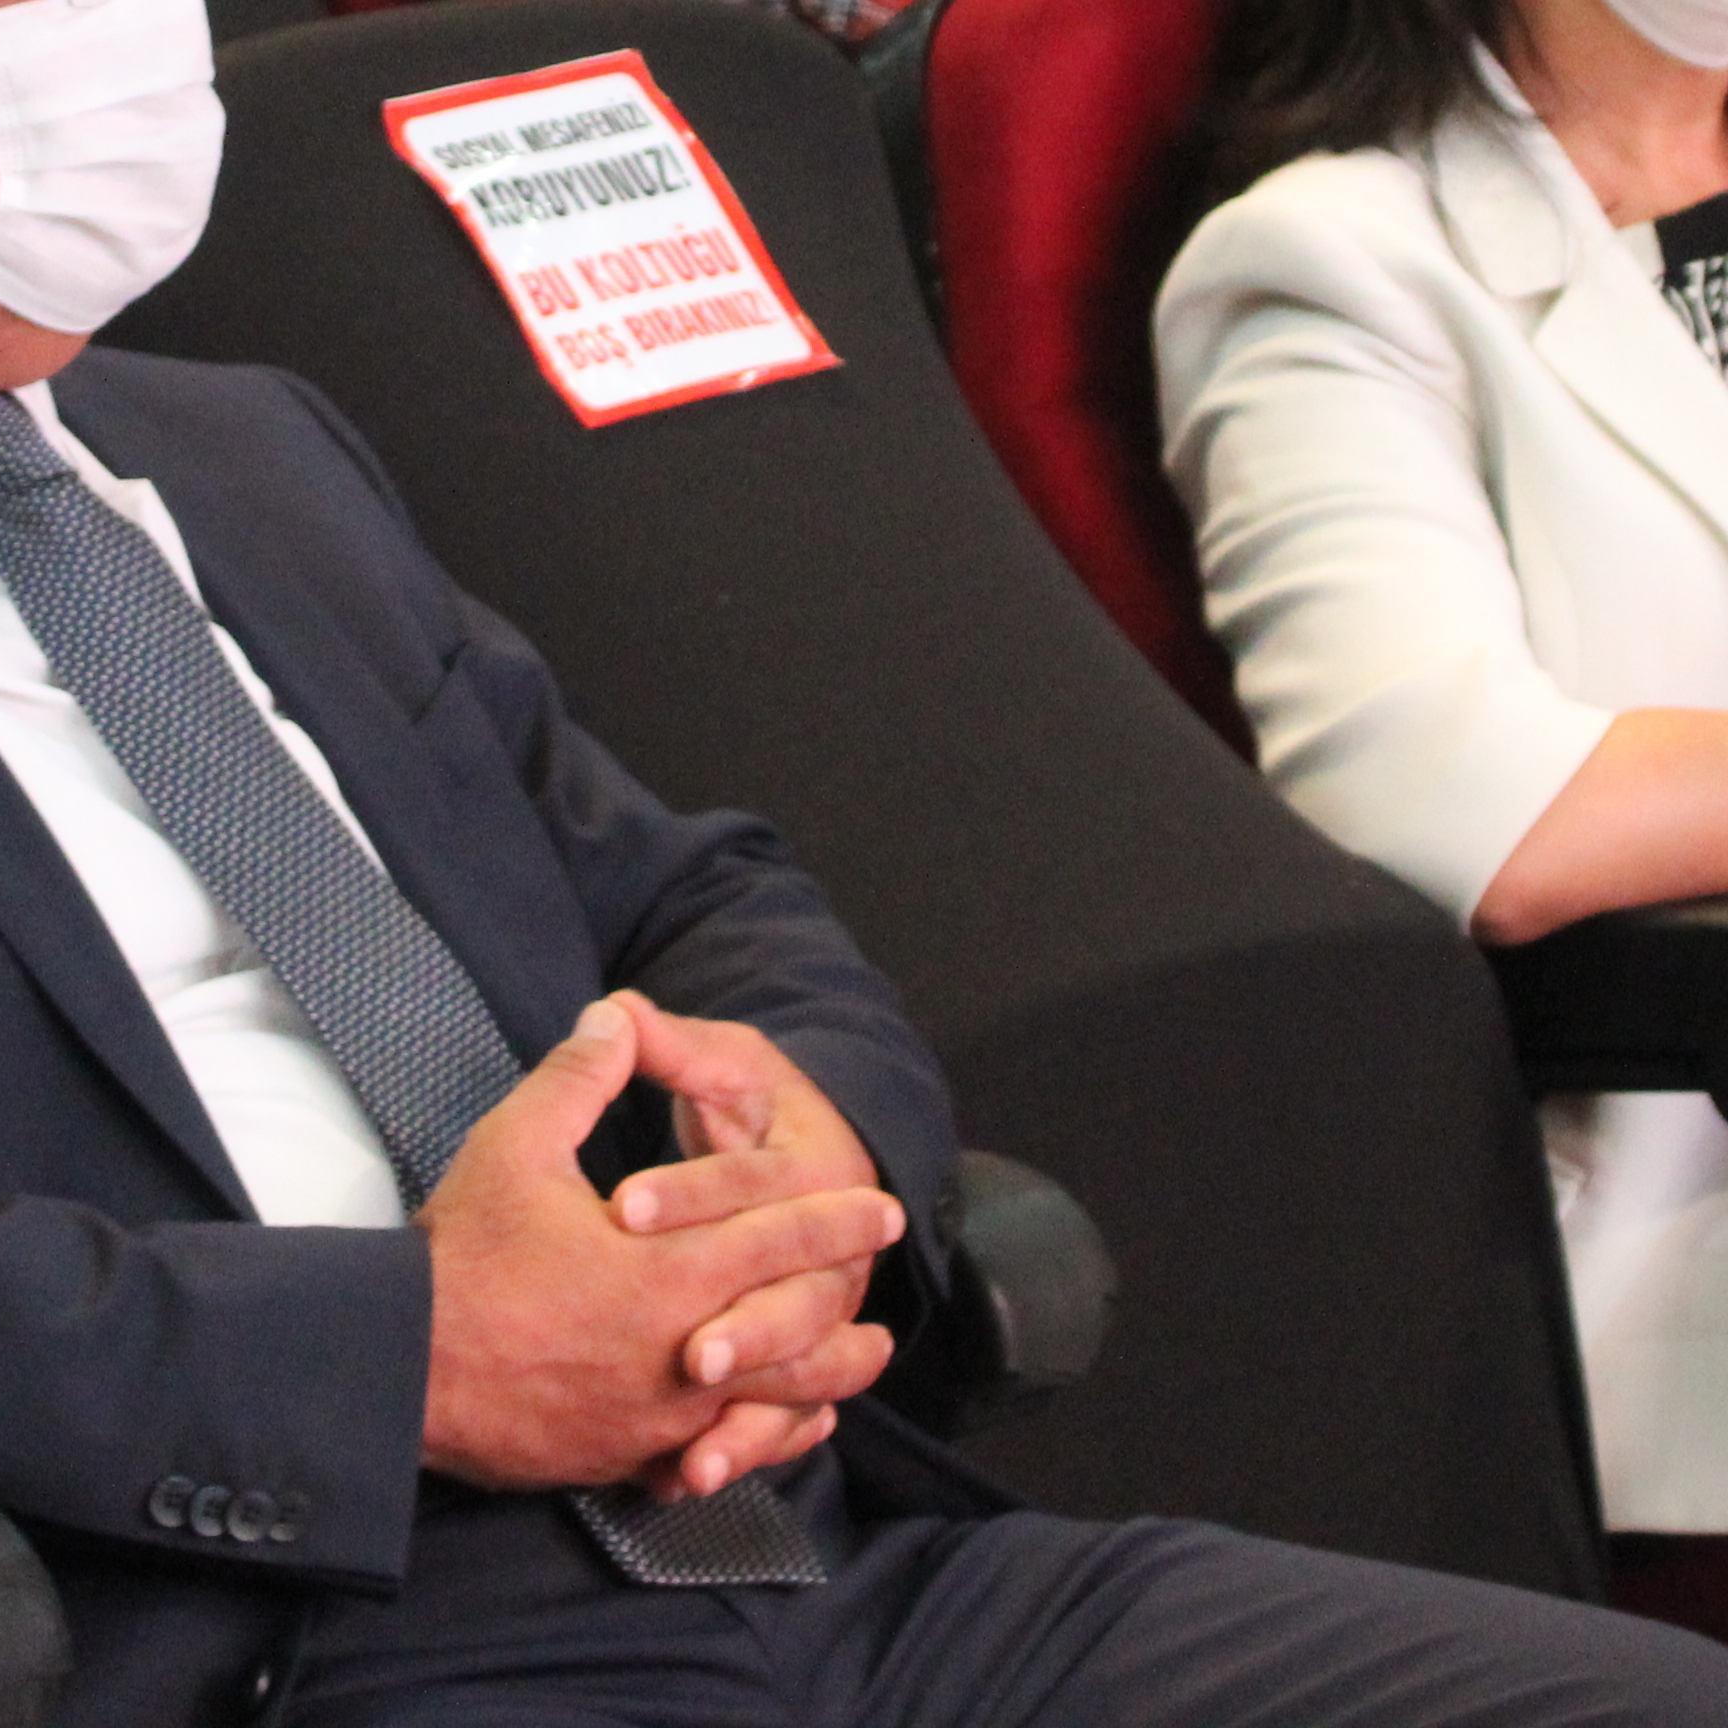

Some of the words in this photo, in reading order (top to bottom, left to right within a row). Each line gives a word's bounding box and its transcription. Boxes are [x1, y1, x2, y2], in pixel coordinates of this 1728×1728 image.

[468, 142, 692, 228] KORUYUNUZ!
[519, 263, 580, 316] BU
[573, 223, 741, 302] KOLTUĞU
[554, 324, 635, 370] BOŞ
[622, 288, 776, 352] BIRAKINIZ!
